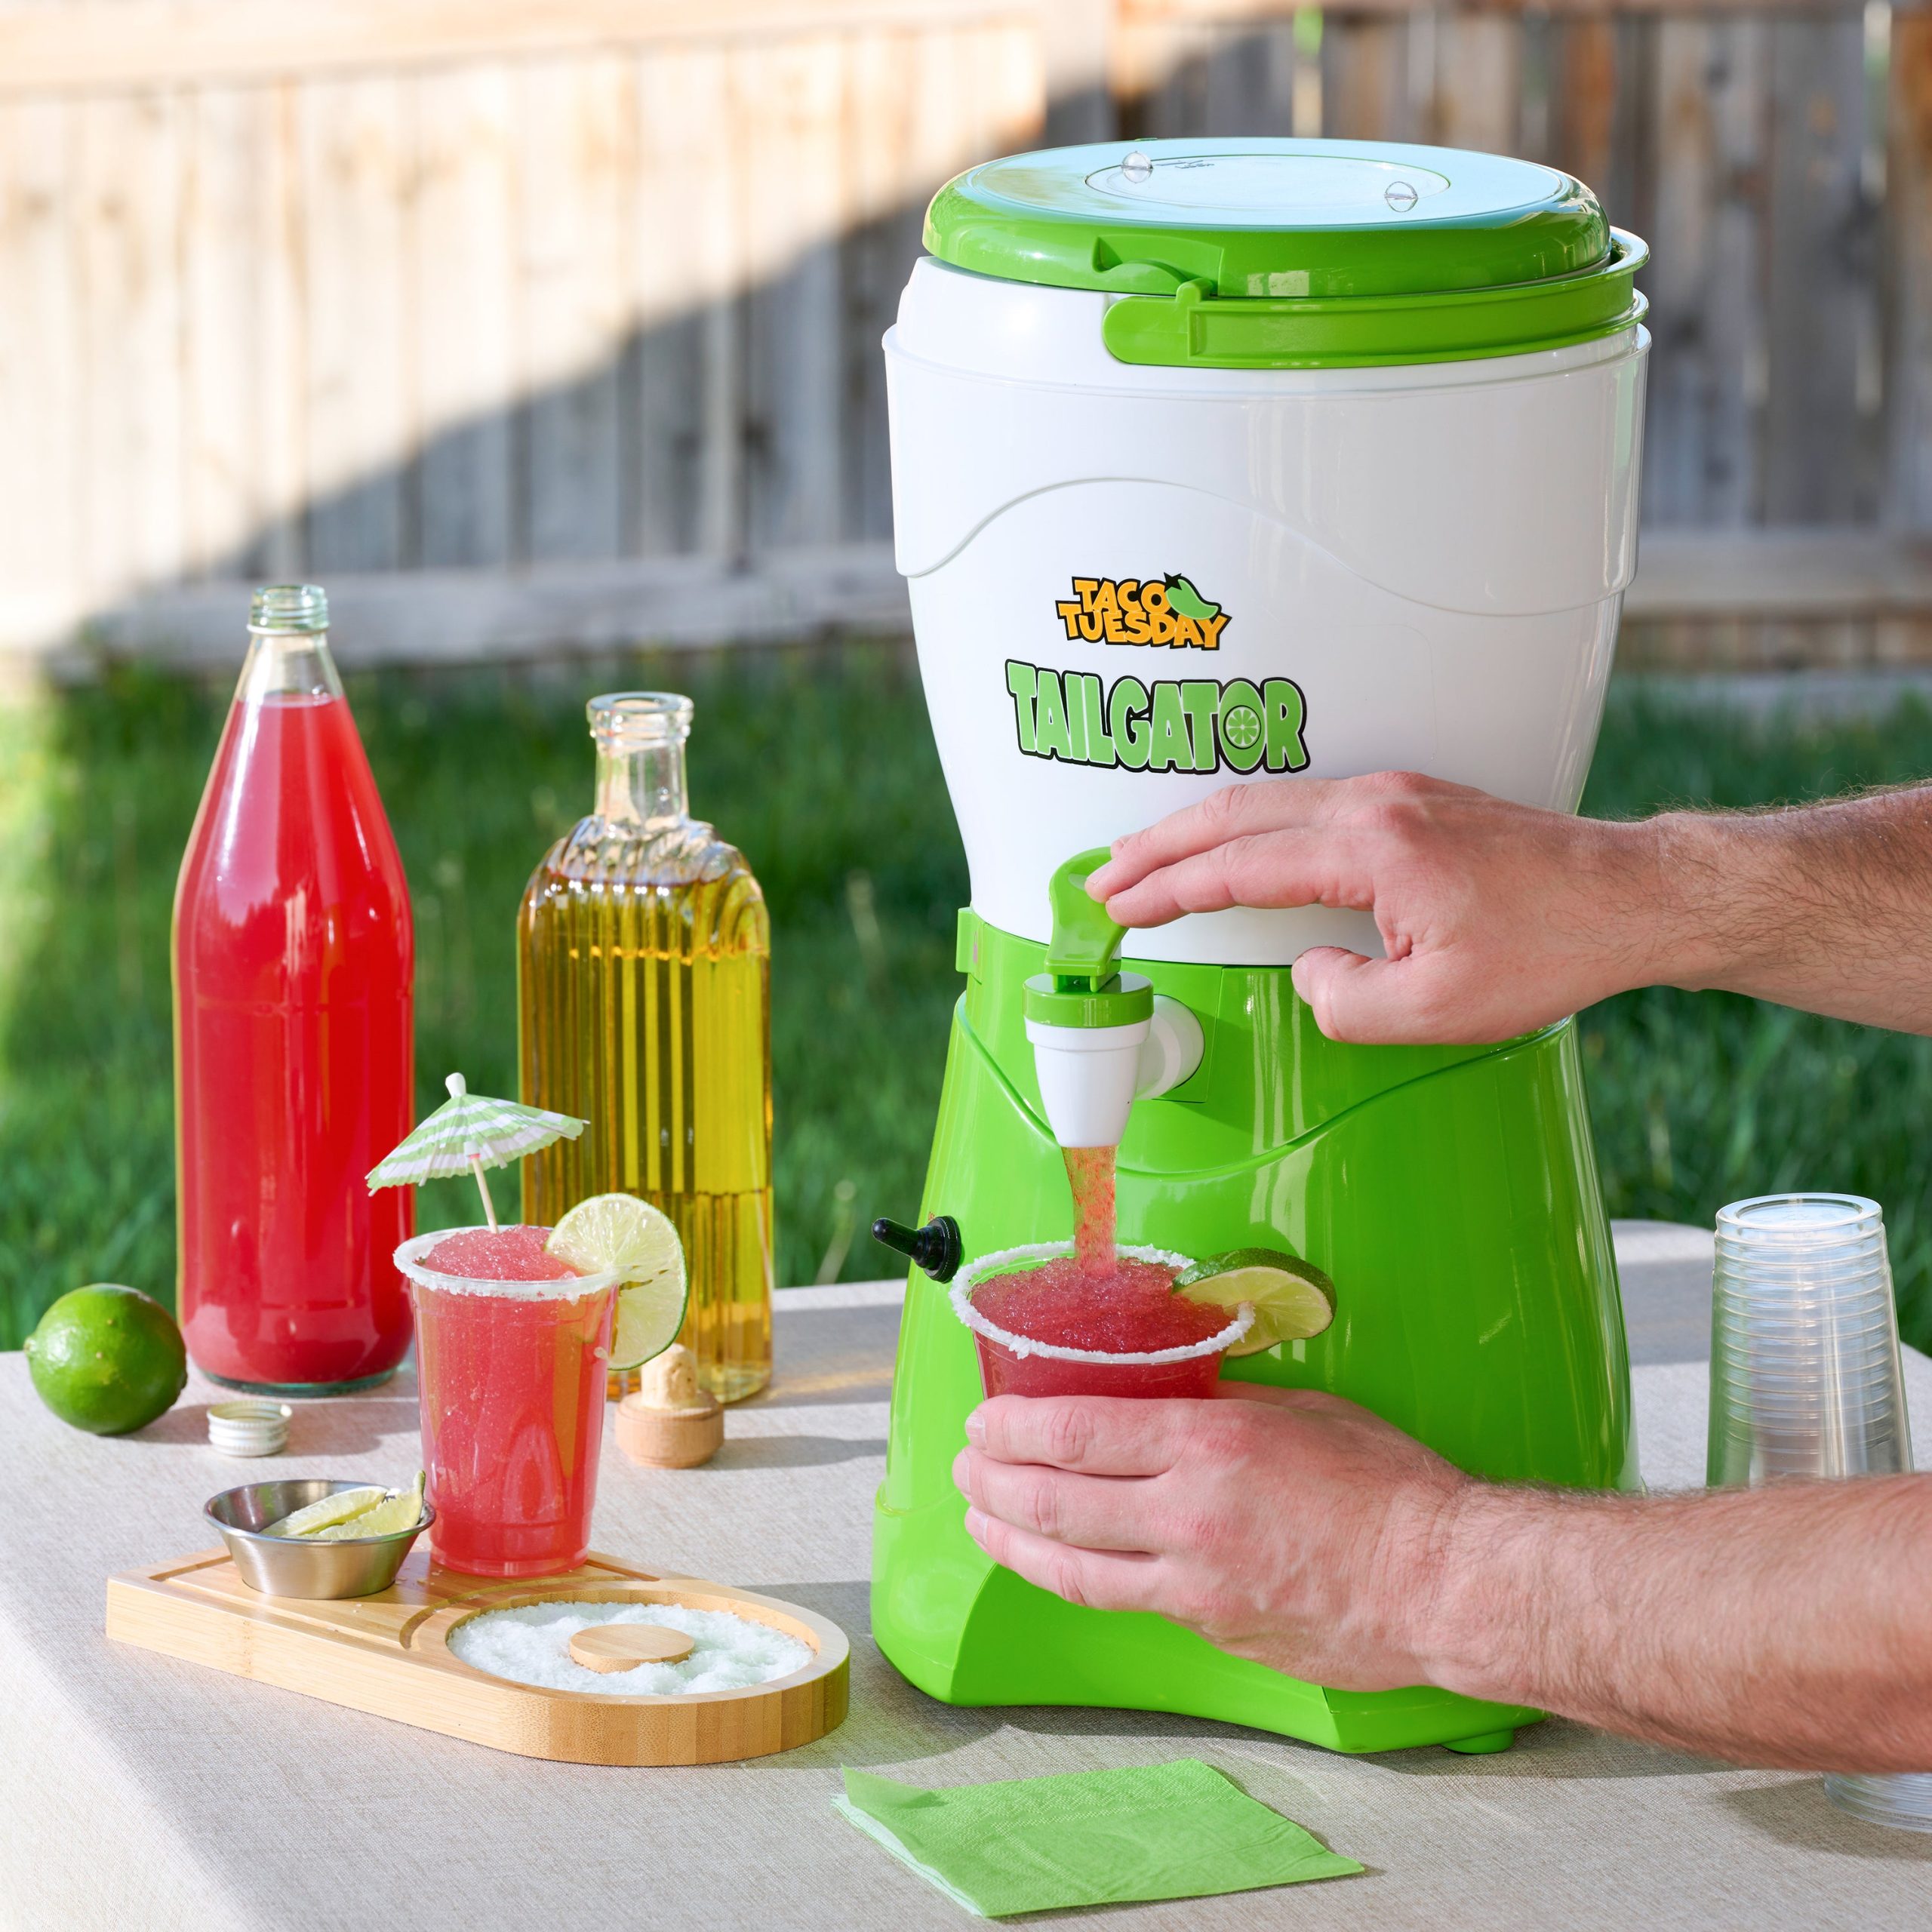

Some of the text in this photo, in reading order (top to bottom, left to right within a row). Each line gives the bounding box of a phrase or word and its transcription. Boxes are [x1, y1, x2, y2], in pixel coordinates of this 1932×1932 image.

[1072, 577, 1171, 614] TACO
[1056, 601, 1232, 651] TUESDAY
[1004, 659, 1311, 775] TAILGATOR
